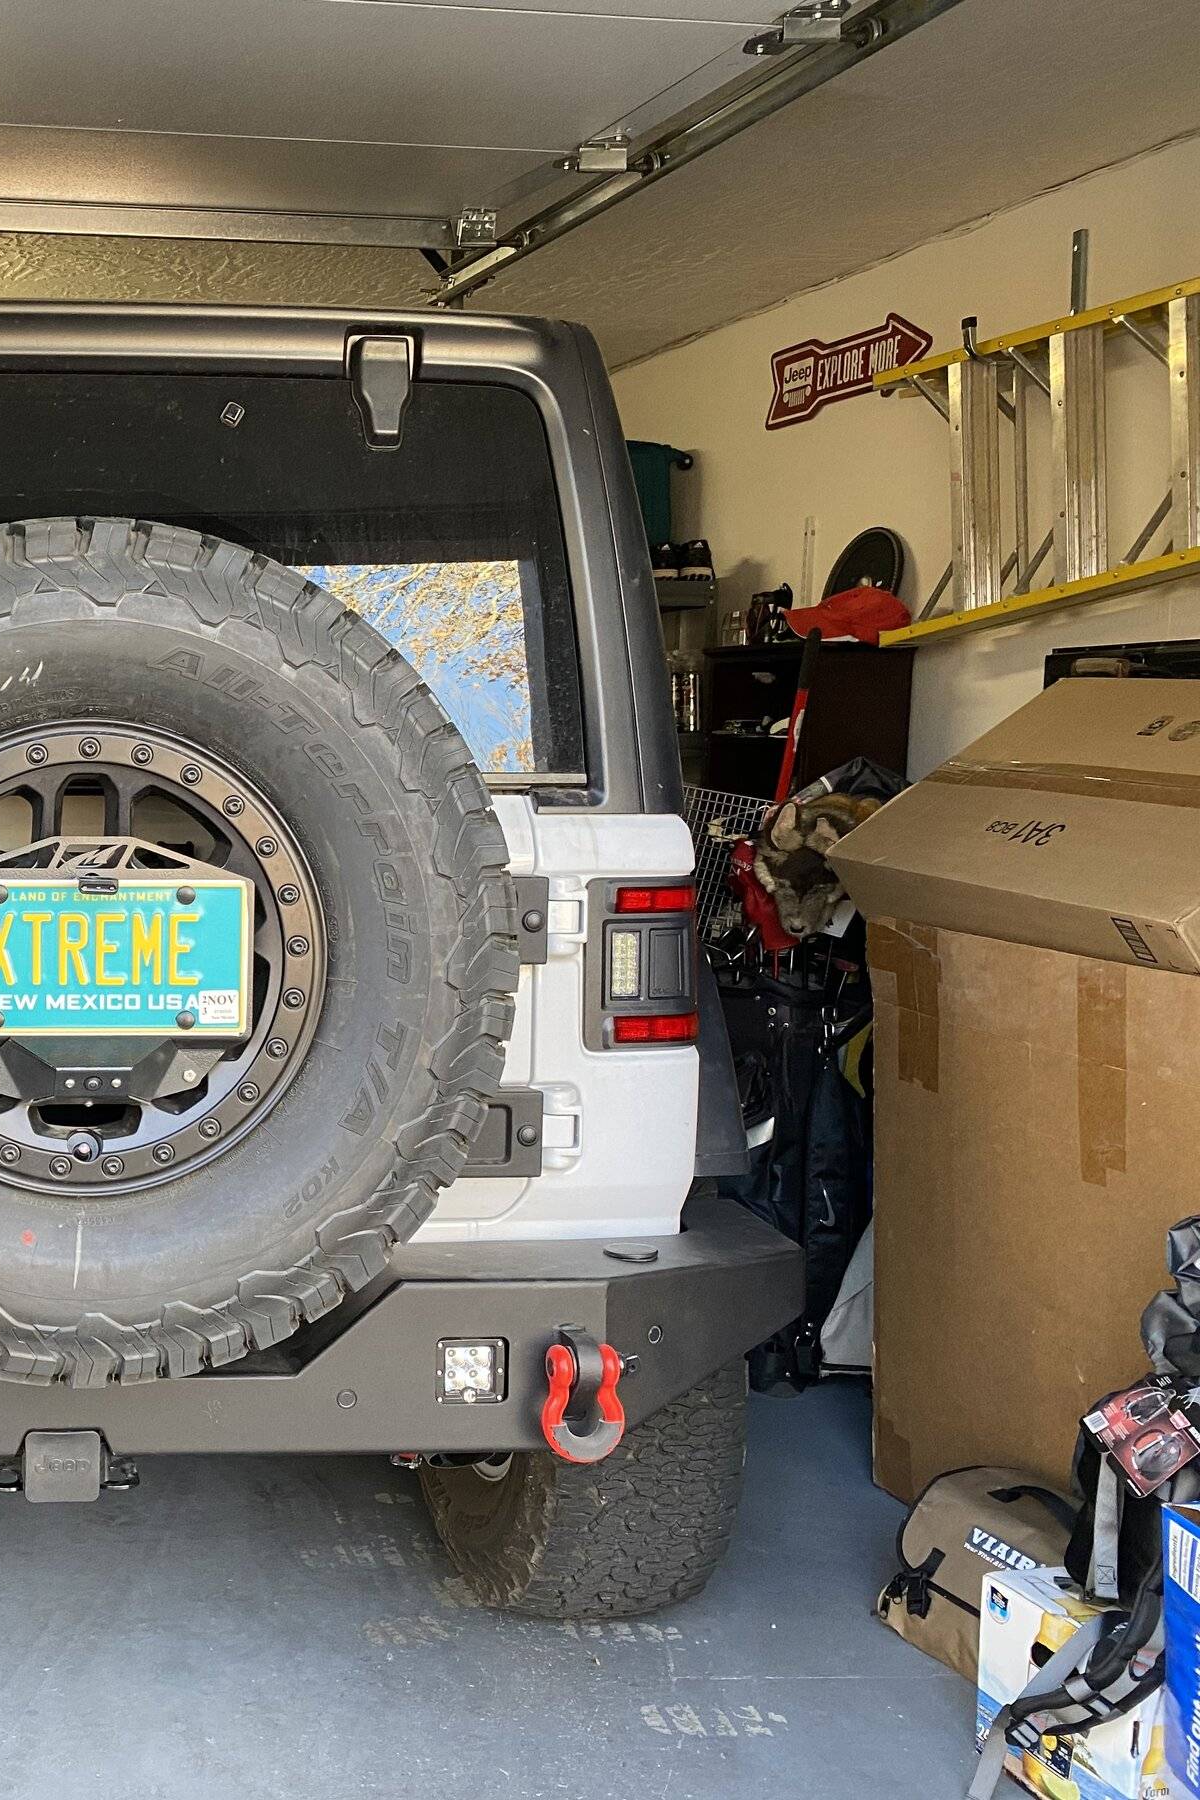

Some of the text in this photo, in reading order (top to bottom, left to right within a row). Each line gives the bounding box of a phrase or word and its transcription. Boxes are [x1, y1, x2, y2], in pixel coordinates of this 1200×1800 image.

[816, 335, 902, 391] EXPLORE MORE
[784, 365, 812, 385] Jeep
[11, 891, 172, 902] LAND OF ENCHANTMENT
[45, 993, 141, 1011] MEXICO
[148, 993, 200, 1011] USA
[208, 995, 237, 1006] NOV
[34, 1454, 92, 1476] Jeep
[972, 1527, 1037, 1571] VIAIR
[1186, 1734, 1200, 1788] Find
